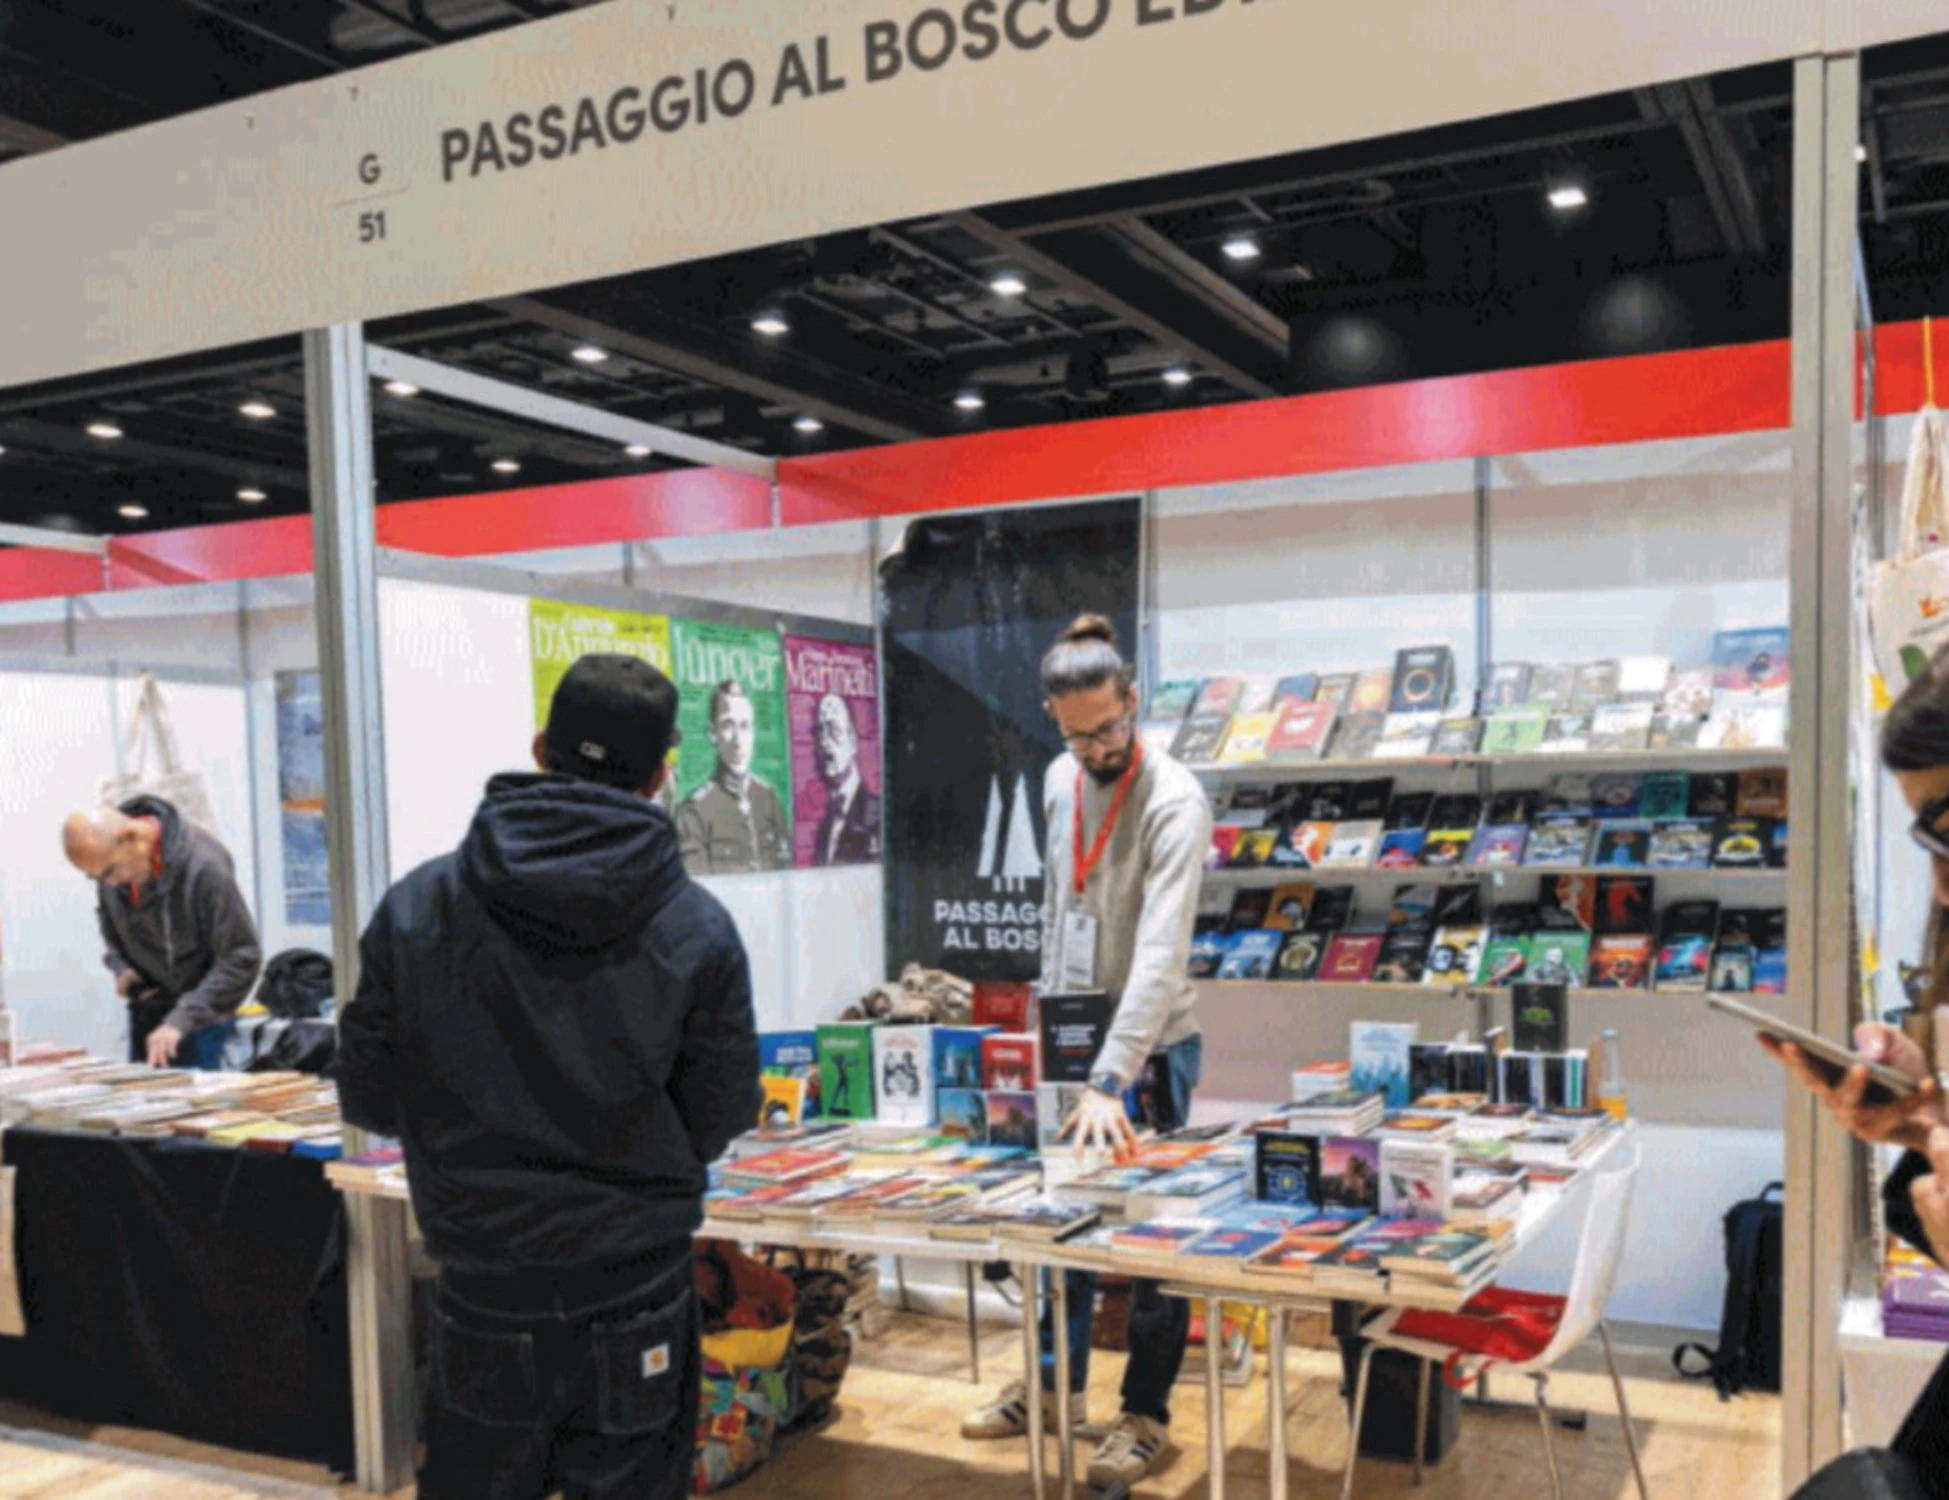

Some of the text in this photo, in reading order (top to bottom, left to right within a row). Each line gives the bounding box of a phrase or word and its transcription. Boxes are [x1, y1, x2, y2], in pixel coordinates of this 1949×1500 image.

[440, 0, 1110, 183] PASSAGGIO AL BOSCO
[357, 153, 382, 185] G
[358, 211, 387, 243] 51
[943, 926, 1042, 952] AL BOS
